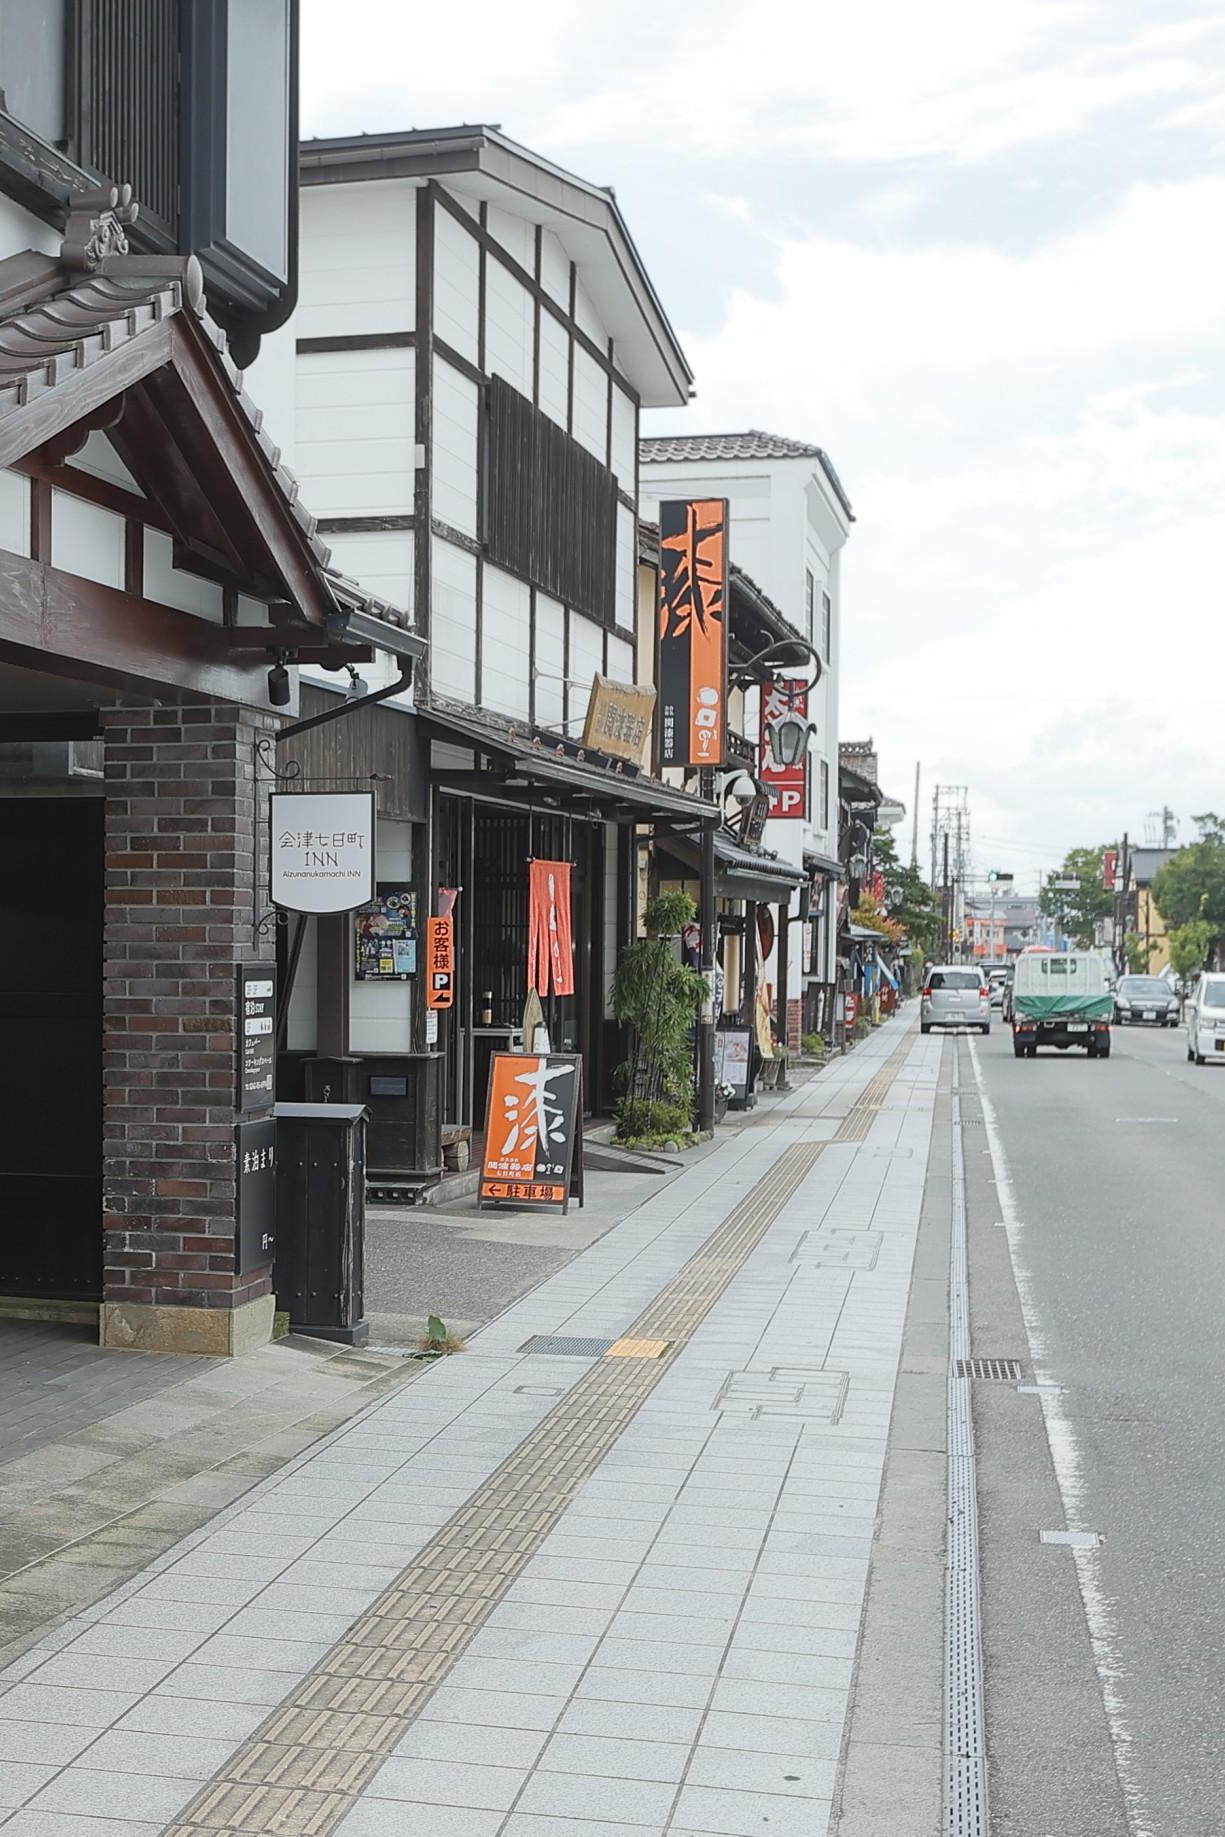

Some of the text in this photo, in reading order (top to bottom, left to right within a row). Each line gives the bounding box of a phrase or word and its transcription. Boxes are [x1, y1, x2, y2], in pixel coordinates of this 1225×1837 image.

[782, 791, 801, 812] P
[279, 831, 365, 849] 会津七日町
[304, 851, 338, 867] INN
[346, 870, 361, 878] INN
[434, 921, 450, 989] お客様 P
[501, 1057, 575, 1159] 漆
[507, 1184, 553, 1200] 駐車場
